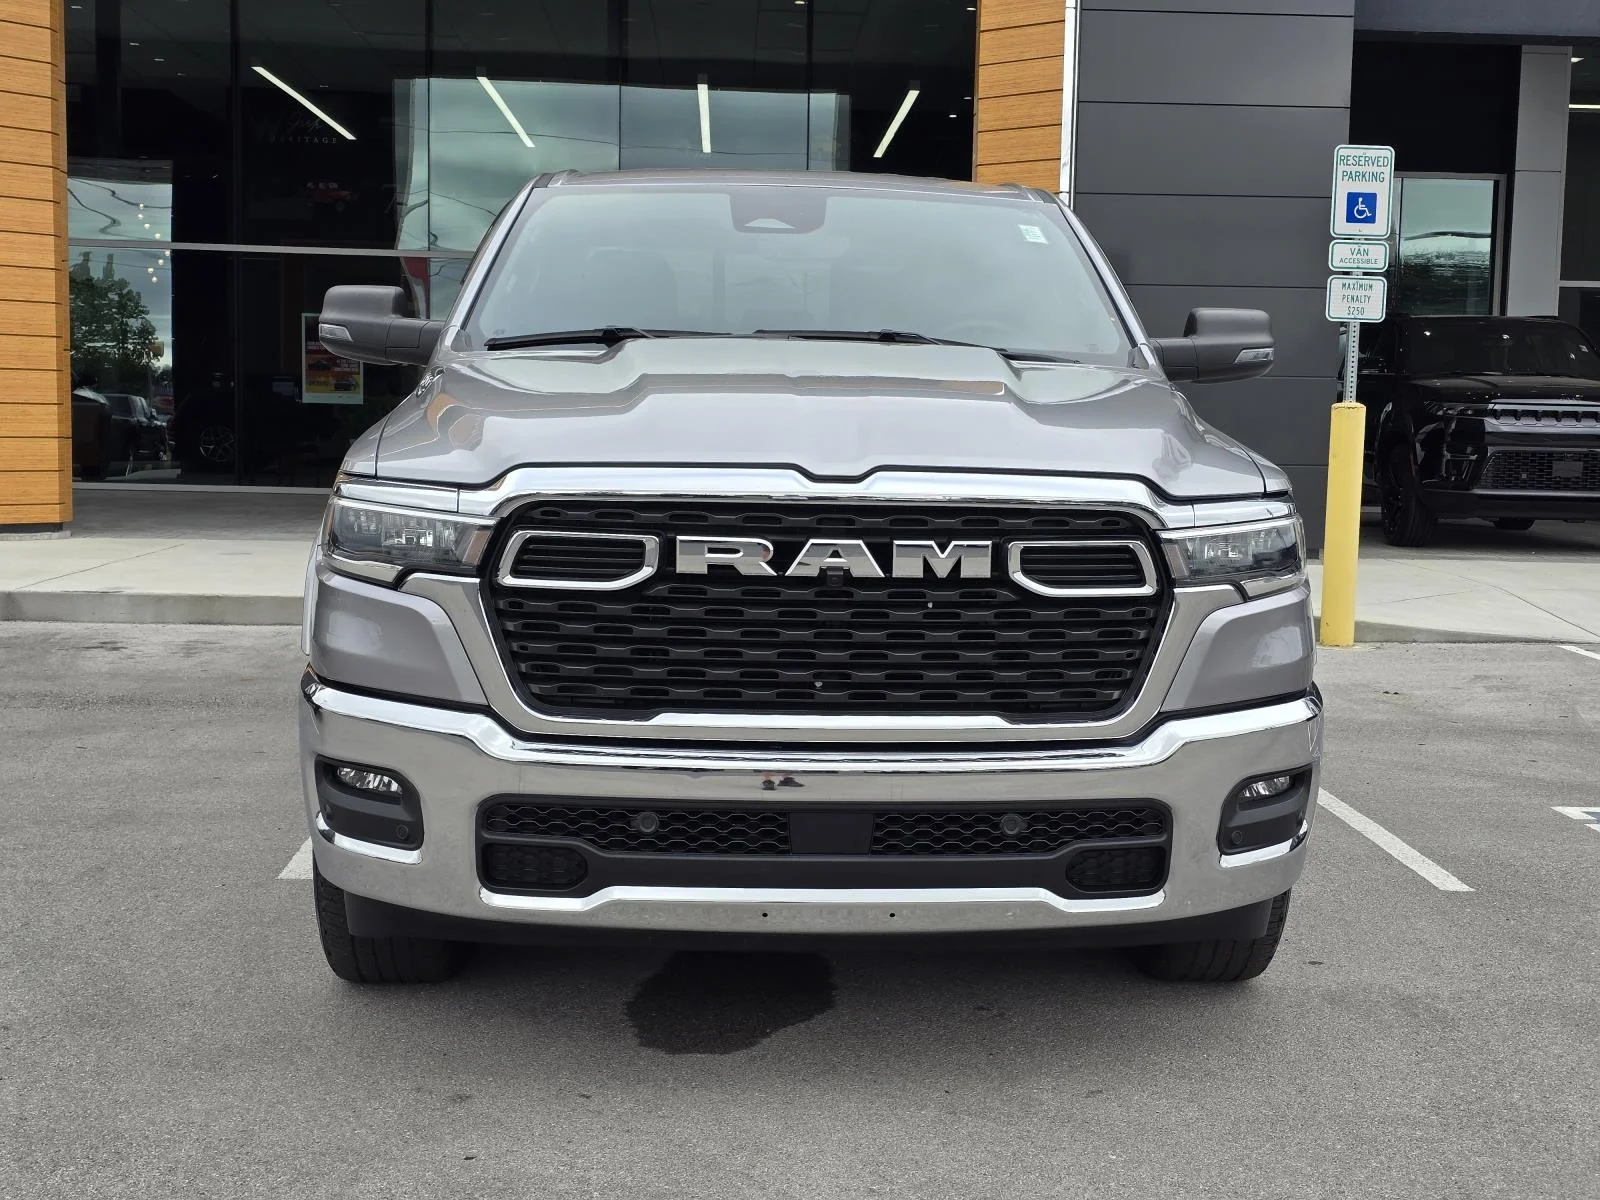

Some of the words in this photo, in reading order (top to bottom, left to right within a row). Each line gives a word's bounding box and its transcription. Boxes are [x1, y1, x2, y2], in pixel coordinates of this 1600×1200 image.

[1339, 154, 1389, 168] RESERVED
[1342, 170, 1385, 183] PARKING
[1350, 248, 1369, 257] VAN
[1339, 257, 1378, 265] ACCESSIBLE
[1341, 281, 1373, 292] MAXIMUM
[1341, 294, 1371, 304] PENALTY
[1347, 305, 1365, 316] $250
[676, 535, 993, 578] RAM
